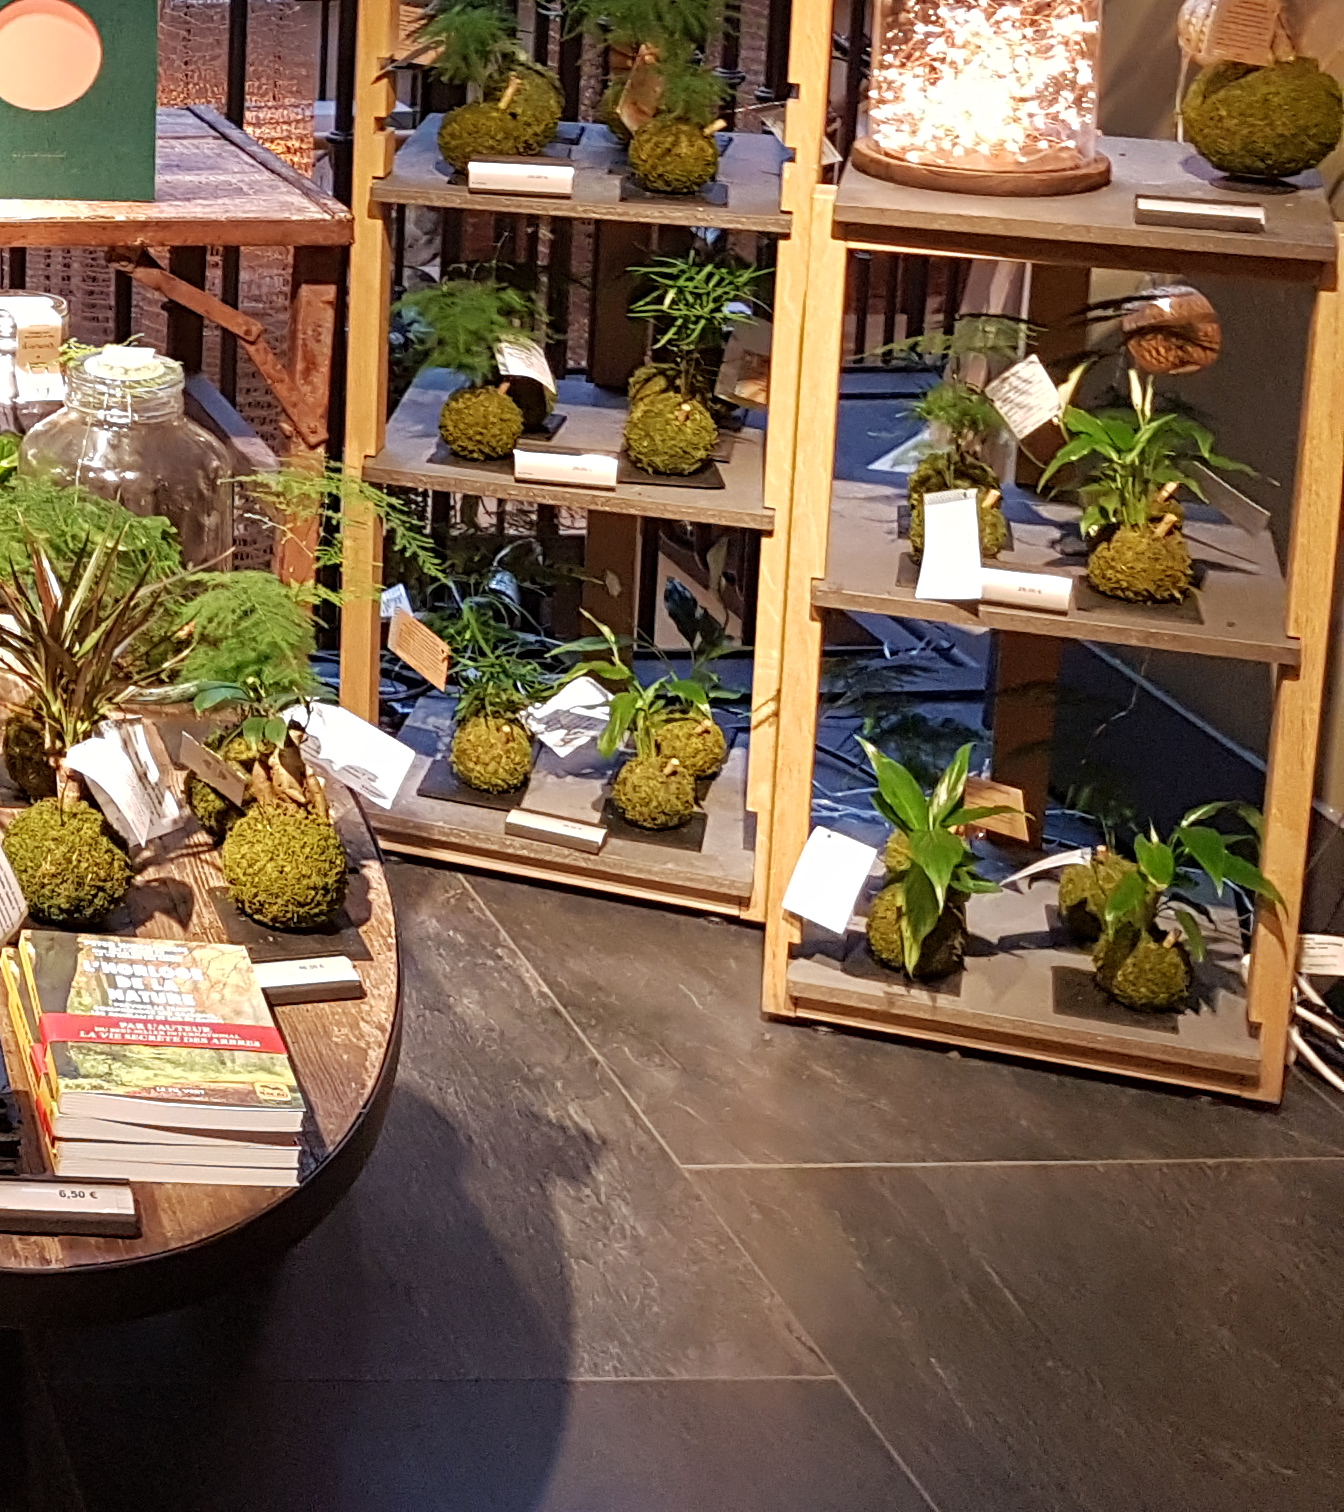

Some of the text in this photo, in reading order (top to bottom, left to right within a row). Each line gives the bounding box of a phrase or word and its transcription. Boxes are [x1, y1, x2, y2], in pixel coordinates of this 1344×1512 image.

[82, 959, 205, 981] L'HORLOGE
[115, 975, 180, 992] DE LA
[107, 988, 196, 1007] NATURE
[119, 1022, 145, 1030] PAR
[79, 1030, 98, 1038] LA
[101, 1031, 123, 1040] VIE
[183, 1036, 209, 1045] DES
[210, 1037, 261, 1048] ARBRES
[58, 1189, 98, 1199] 6,50 €
